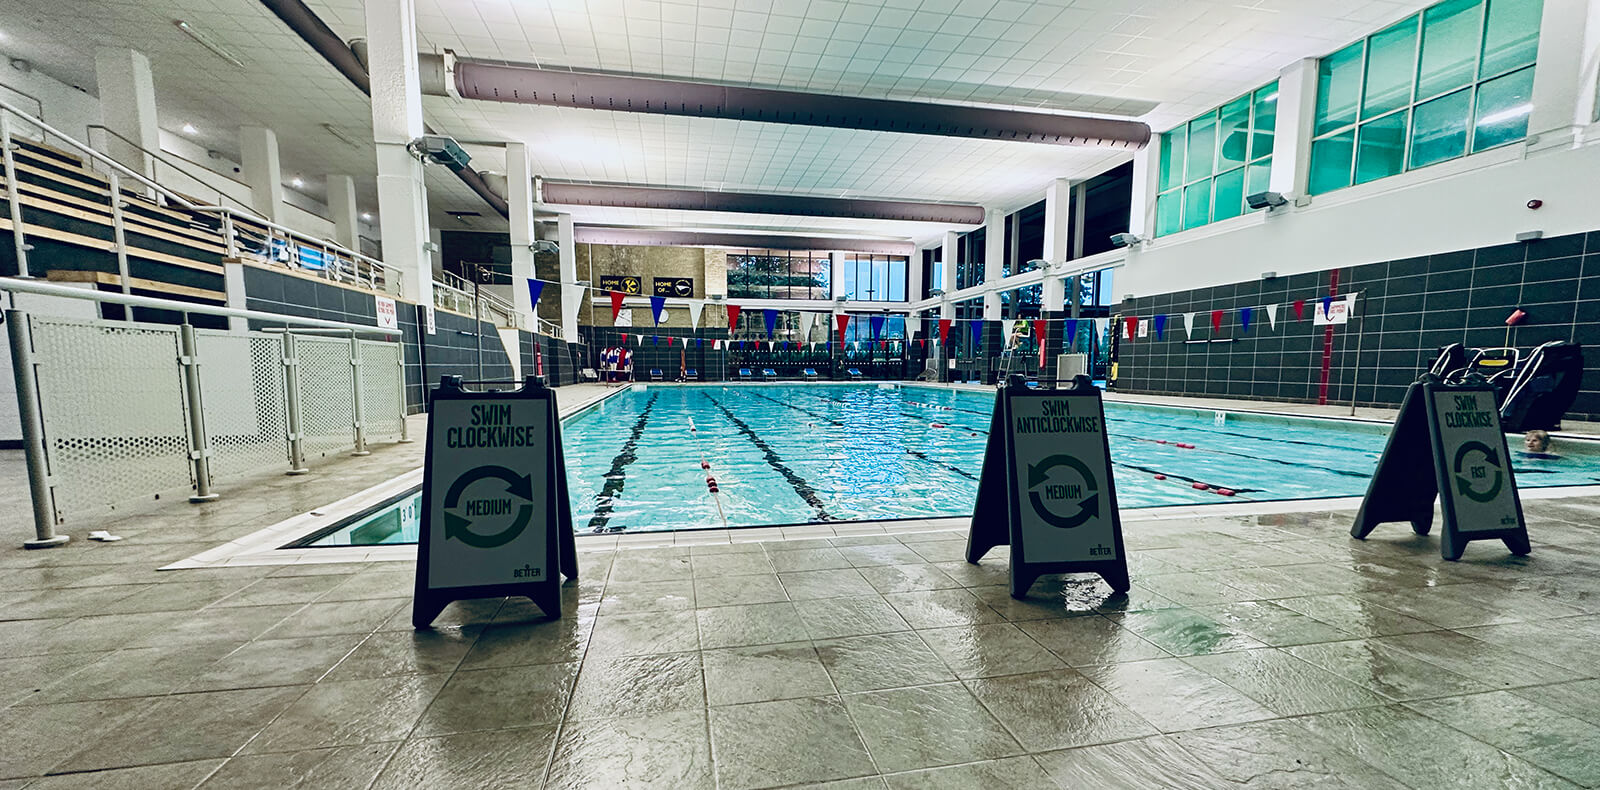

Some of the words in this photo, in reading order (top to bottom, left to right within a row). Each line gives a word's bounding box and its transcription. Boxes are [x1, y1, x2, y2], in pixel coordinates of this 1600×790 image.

[1041, 399, 1070, 417] SWIM
[1454, 395, 1478, 411] SWIM
[470, 404, 511, 426] SWIM
[1445, 411, 1494, 428] CLOCKWISE
[1016, 416, 1099, 433] ANTICLOCKWISE
[446, 425, 535, 449] CLOCKWISE
[1470, 466, 1486, 479] FAST
[1045, 484, 1082, 500] MEDIUM
[466, 498, 512, 516] MEDIUM
[513, 563, 541, 578] BETTER
